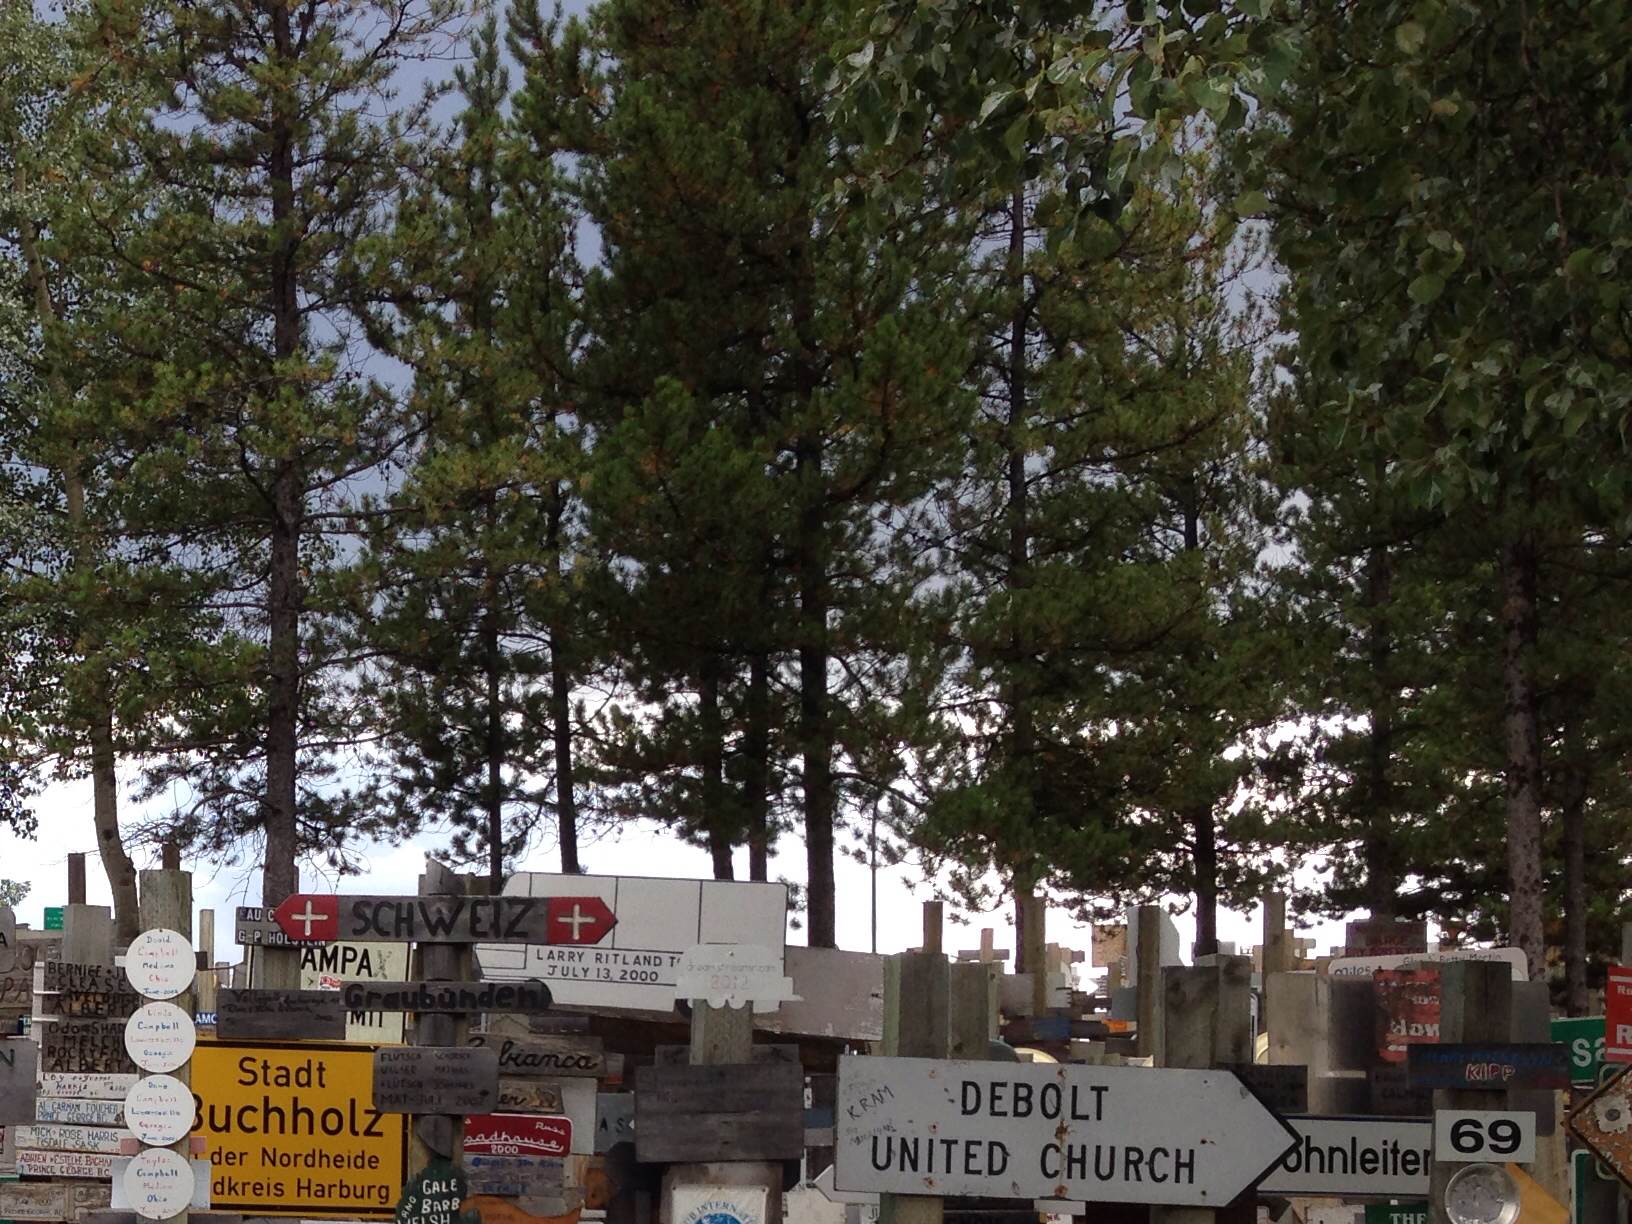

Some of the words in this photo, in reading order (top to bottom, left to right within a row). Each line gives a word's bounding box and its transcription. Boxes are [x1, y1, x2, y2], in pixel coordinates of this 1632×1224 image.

[351, 900, 532, 939] SCHWEIZ
[536, 949, 585, 963] LARRY
[595, 950, 671, 968] RITLAND
[547, 964, 590, 978] JULY
[619, 968, 659, 983] 2000
[238, 1057, 326, 1088] Stadt
[1465, 1063, 1516, 1081] KIPP
[960, 1080, 1110, 1121] DEBOLT
[1449, 1118, 1522, 1155] 69
[210, 1150, 248, 1167] der
[261, 1148, 380, 1170] Nordheide
[870, 1135, 1010, 1177] UNITED
[1039, 1143, 1196, 1185] CHURCH
[296, 1177, 390, 1202] Harburg
[422, 1179, 458, 1193] GALE
[421, 1198, 461, 1214] BARB
